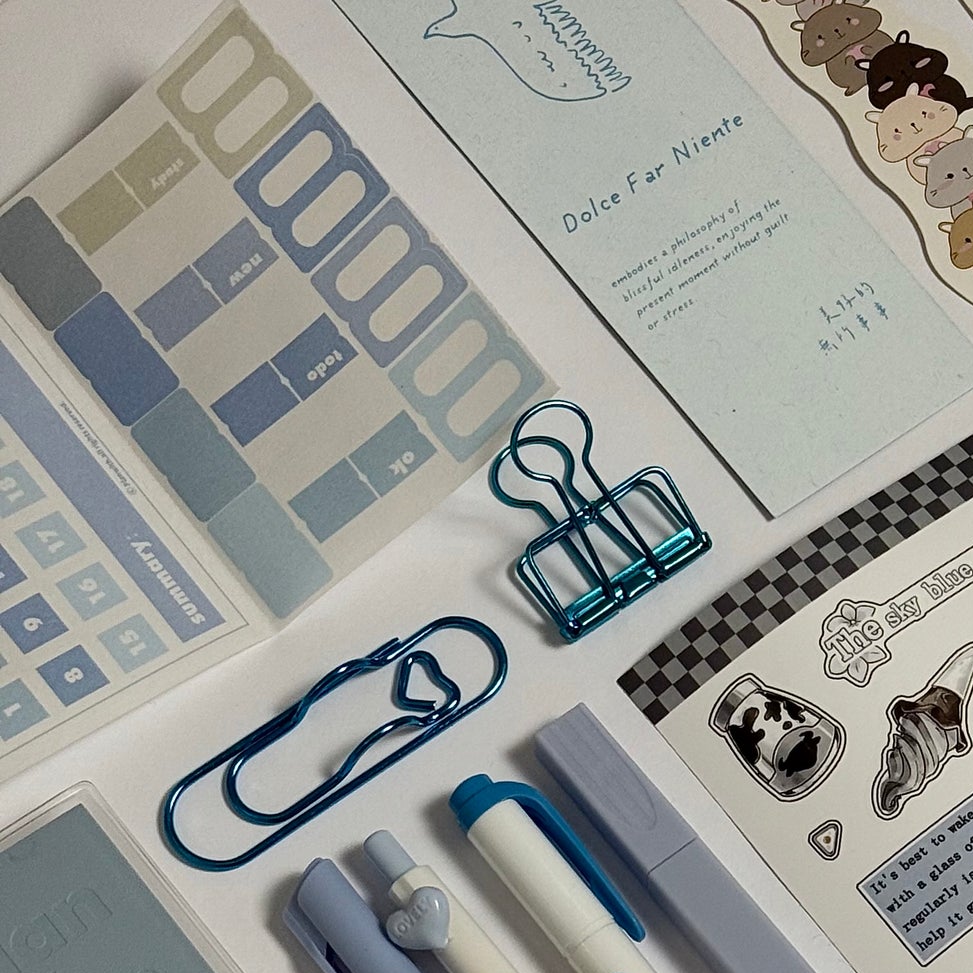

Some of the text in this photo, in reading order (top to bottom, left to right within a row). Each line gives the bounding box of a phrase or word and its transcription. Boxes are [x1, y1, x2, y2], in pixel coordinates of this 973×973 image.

[151, 157, 185, 190] study
[562, 113, 744, 234] Dolce Far Niente
[611, 255, 659, 288] embodies
[670, 211, 727, 253] philosophy
[728, 199, 741, 215] of
[622, 269, 665, 303] blissful
[716, 210, 763, 243] enjoying
[763, 197, 782, 214] the
[227, 253, 263, 287] new
[636, 212, 790, 319] present moment without guilt
[646, 320, 660, 331] or
[306, 349, 343, 384] todo
[388, 446, 417, 476] ok
[36, 530, 65, 553] 17
[78, 577, 106, 605] 16
[118, 628, 147, 658] 15
[824, 619, 884, 663] The
[885, 596, 922, 629] sky
[64, 667, 84, 684] 8
[869, 870, 898, 895] It's
[900, 847, 928, 872] best
[931, 833, 946, 848] to
[886, 890, 914, 914] with
[917, 880, 927, 890] a
[929, 852, 962, 882] glass
[902, 886, 959, 933] regularly
[916, 926, 947, 952] help
[948, 913, 963, 928] it
